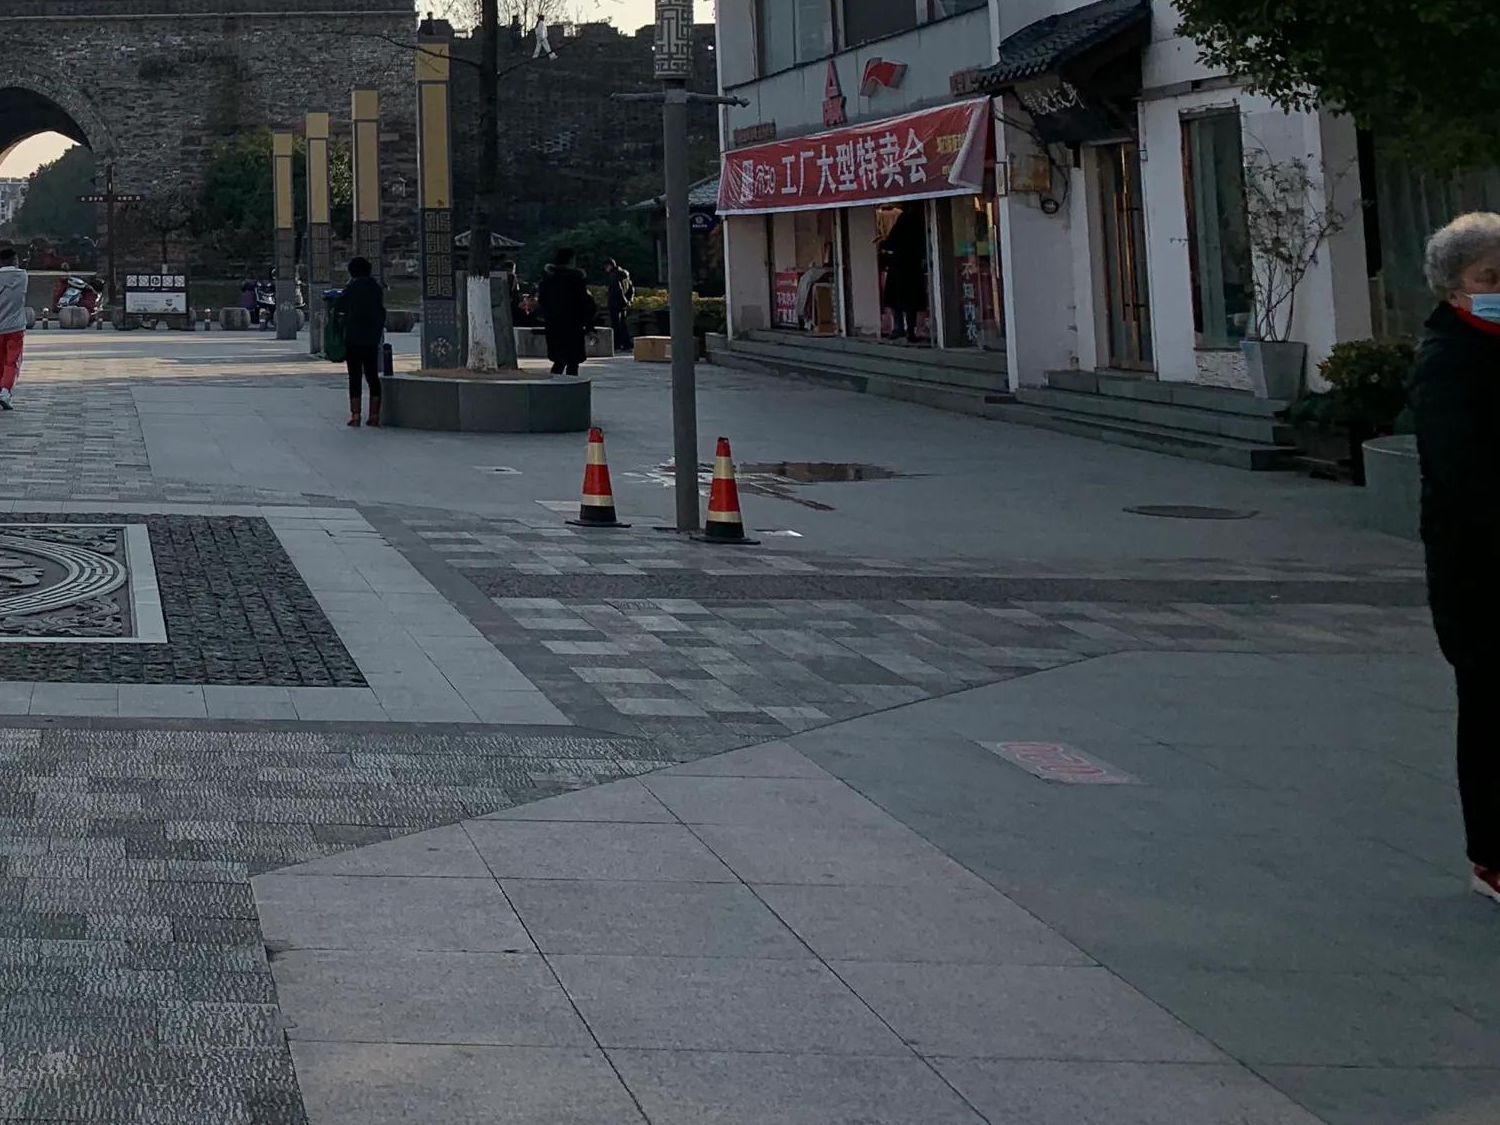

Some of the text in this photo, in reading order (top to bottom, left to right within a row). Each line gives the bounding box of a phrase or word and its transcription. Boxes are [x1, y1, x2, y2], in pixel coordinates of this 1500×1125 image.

[780, 127, 928, 197] 工厂大型特卖会
